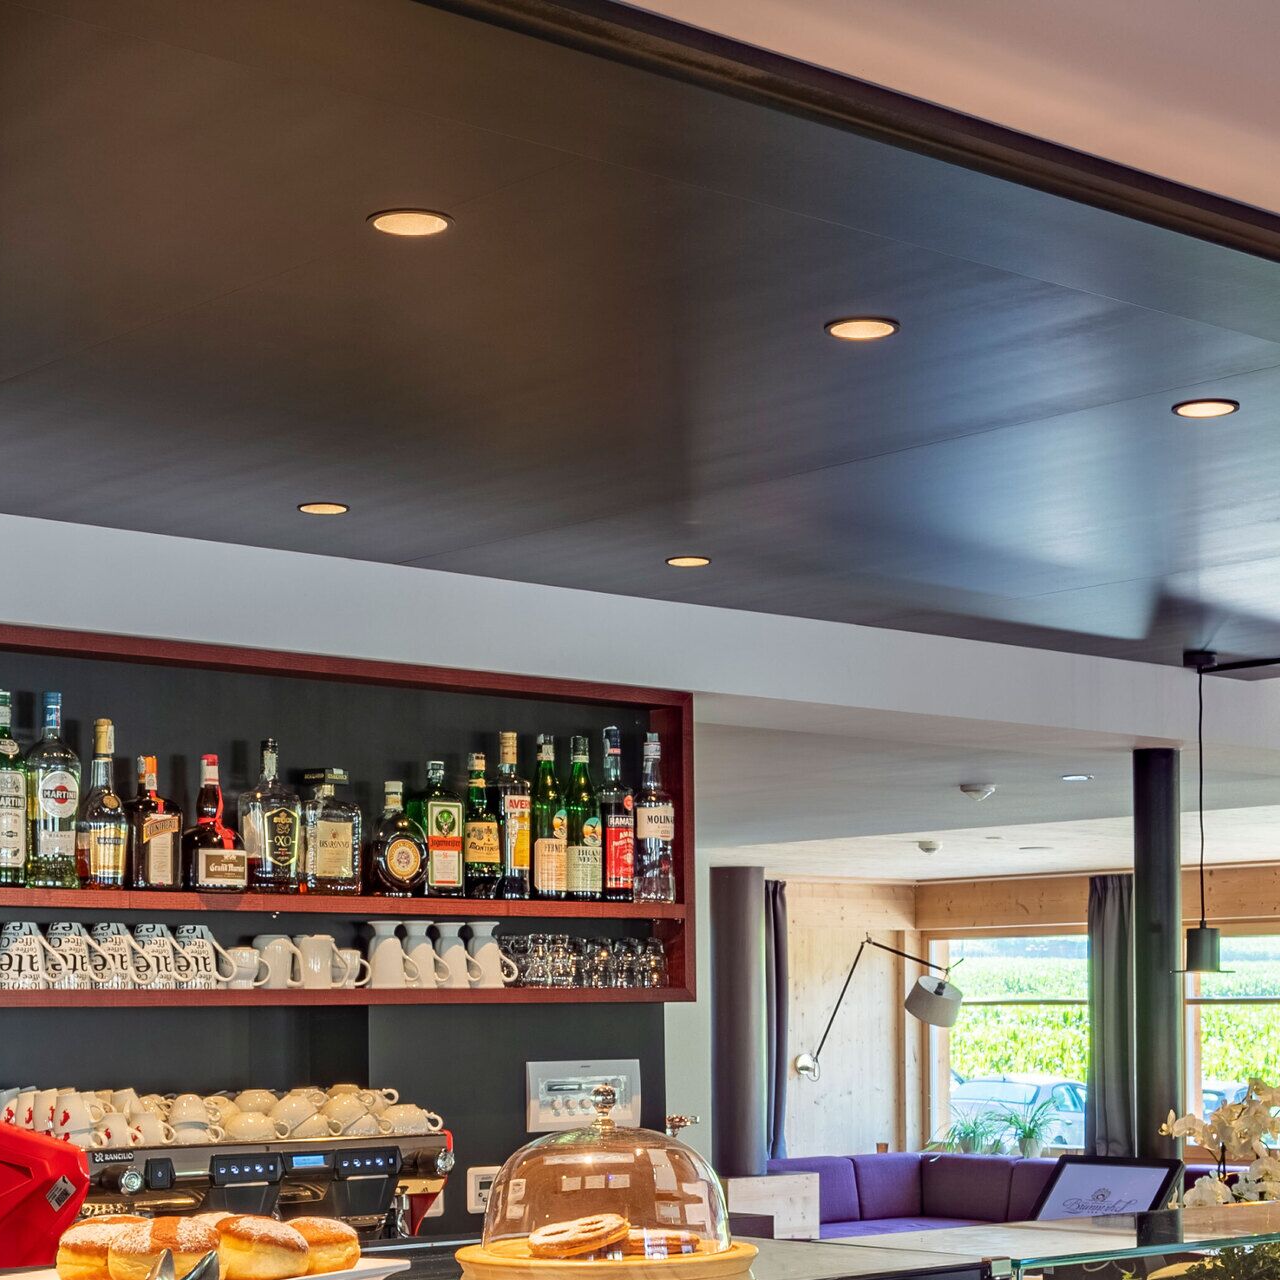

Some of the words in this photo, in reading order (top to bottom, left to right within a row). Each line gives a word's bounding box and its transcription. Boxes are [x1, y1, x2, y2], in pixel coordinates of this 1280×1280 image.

[44, 790, 76, 799] MARTINI
[509, 799, 530, 809] AVER
[104, 1152, 134, 1160] RANCILIO
